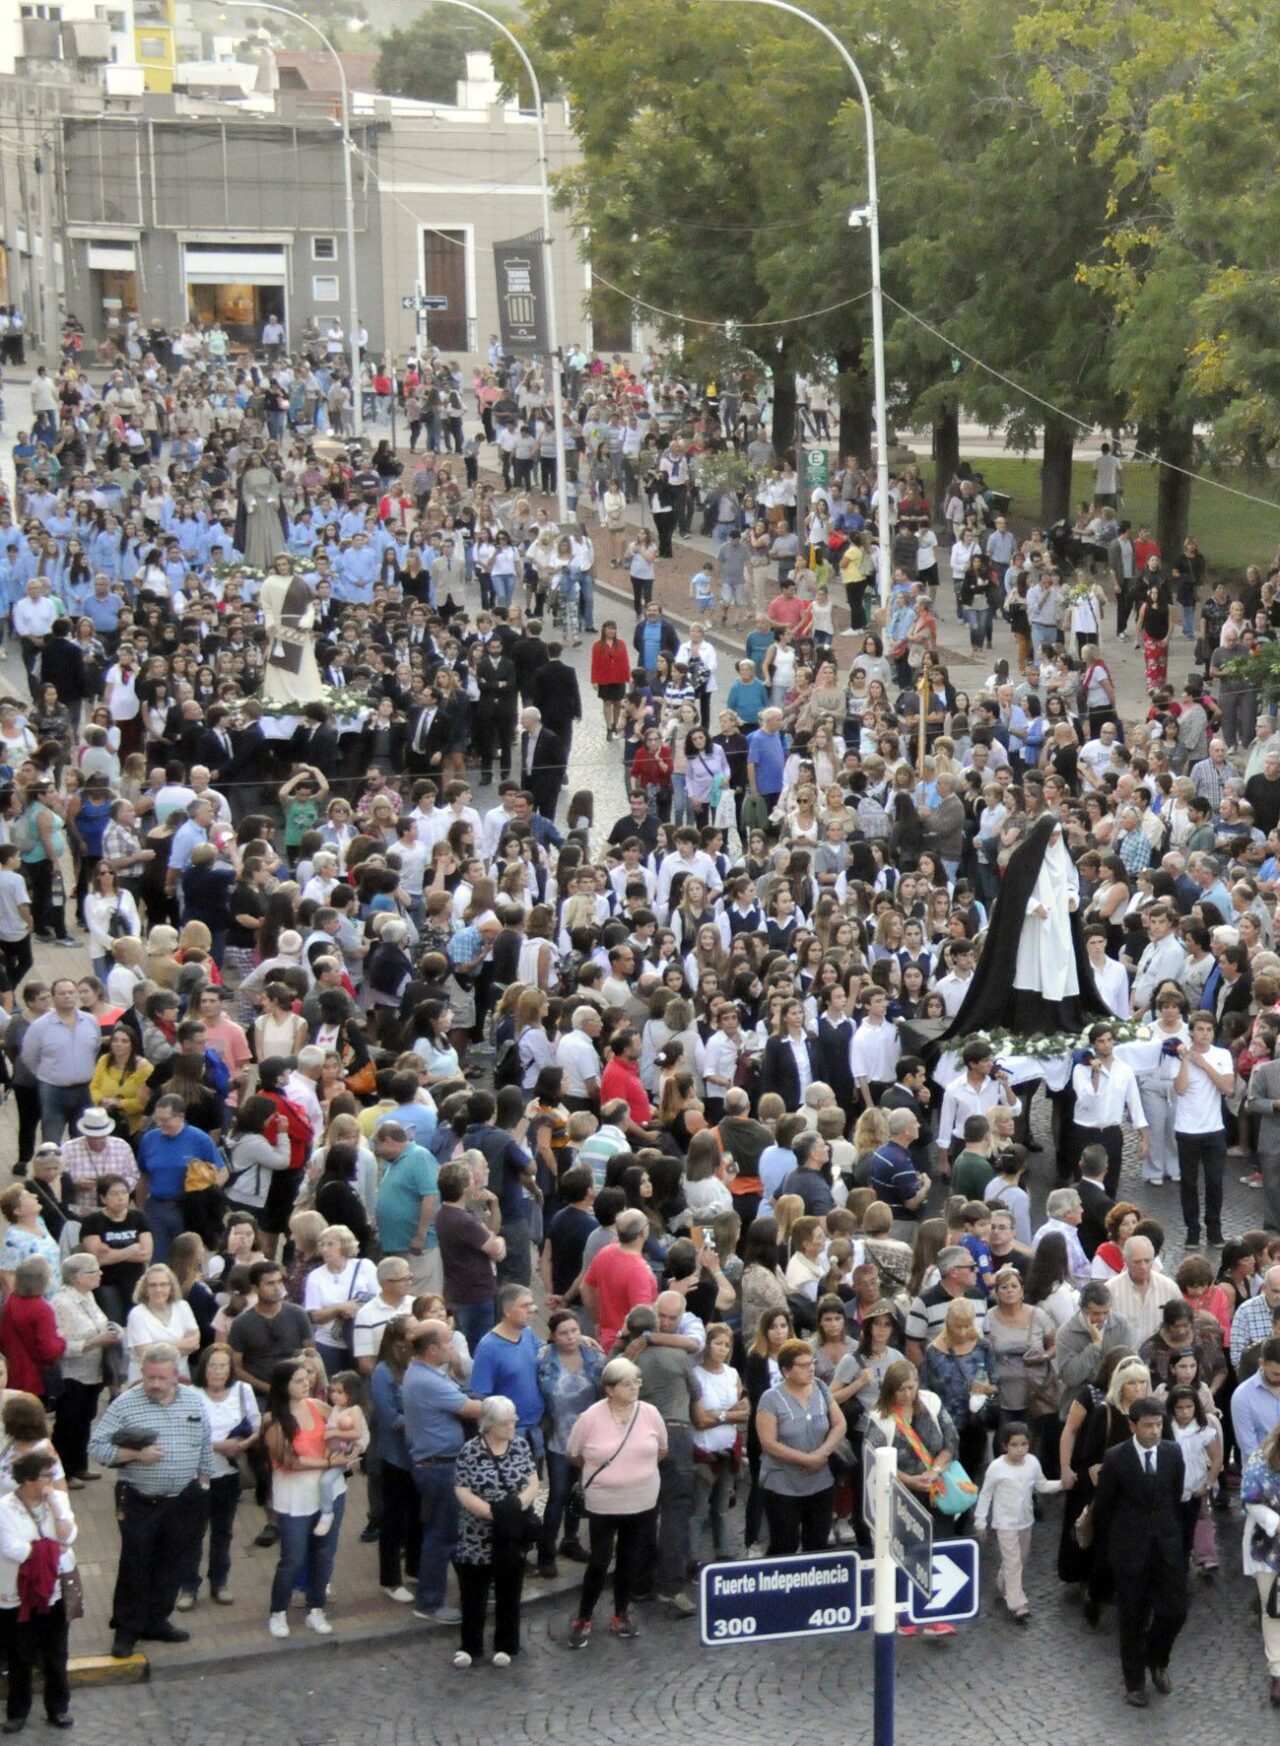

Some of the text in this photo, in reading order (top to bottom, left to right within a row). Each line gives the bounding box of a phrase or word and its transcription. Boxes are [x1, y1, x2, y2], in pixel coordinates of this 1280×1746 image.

[714, 1563, 849, 1596] Fuerte Independencia
[713, 1606, 851, 1638] 300 400
